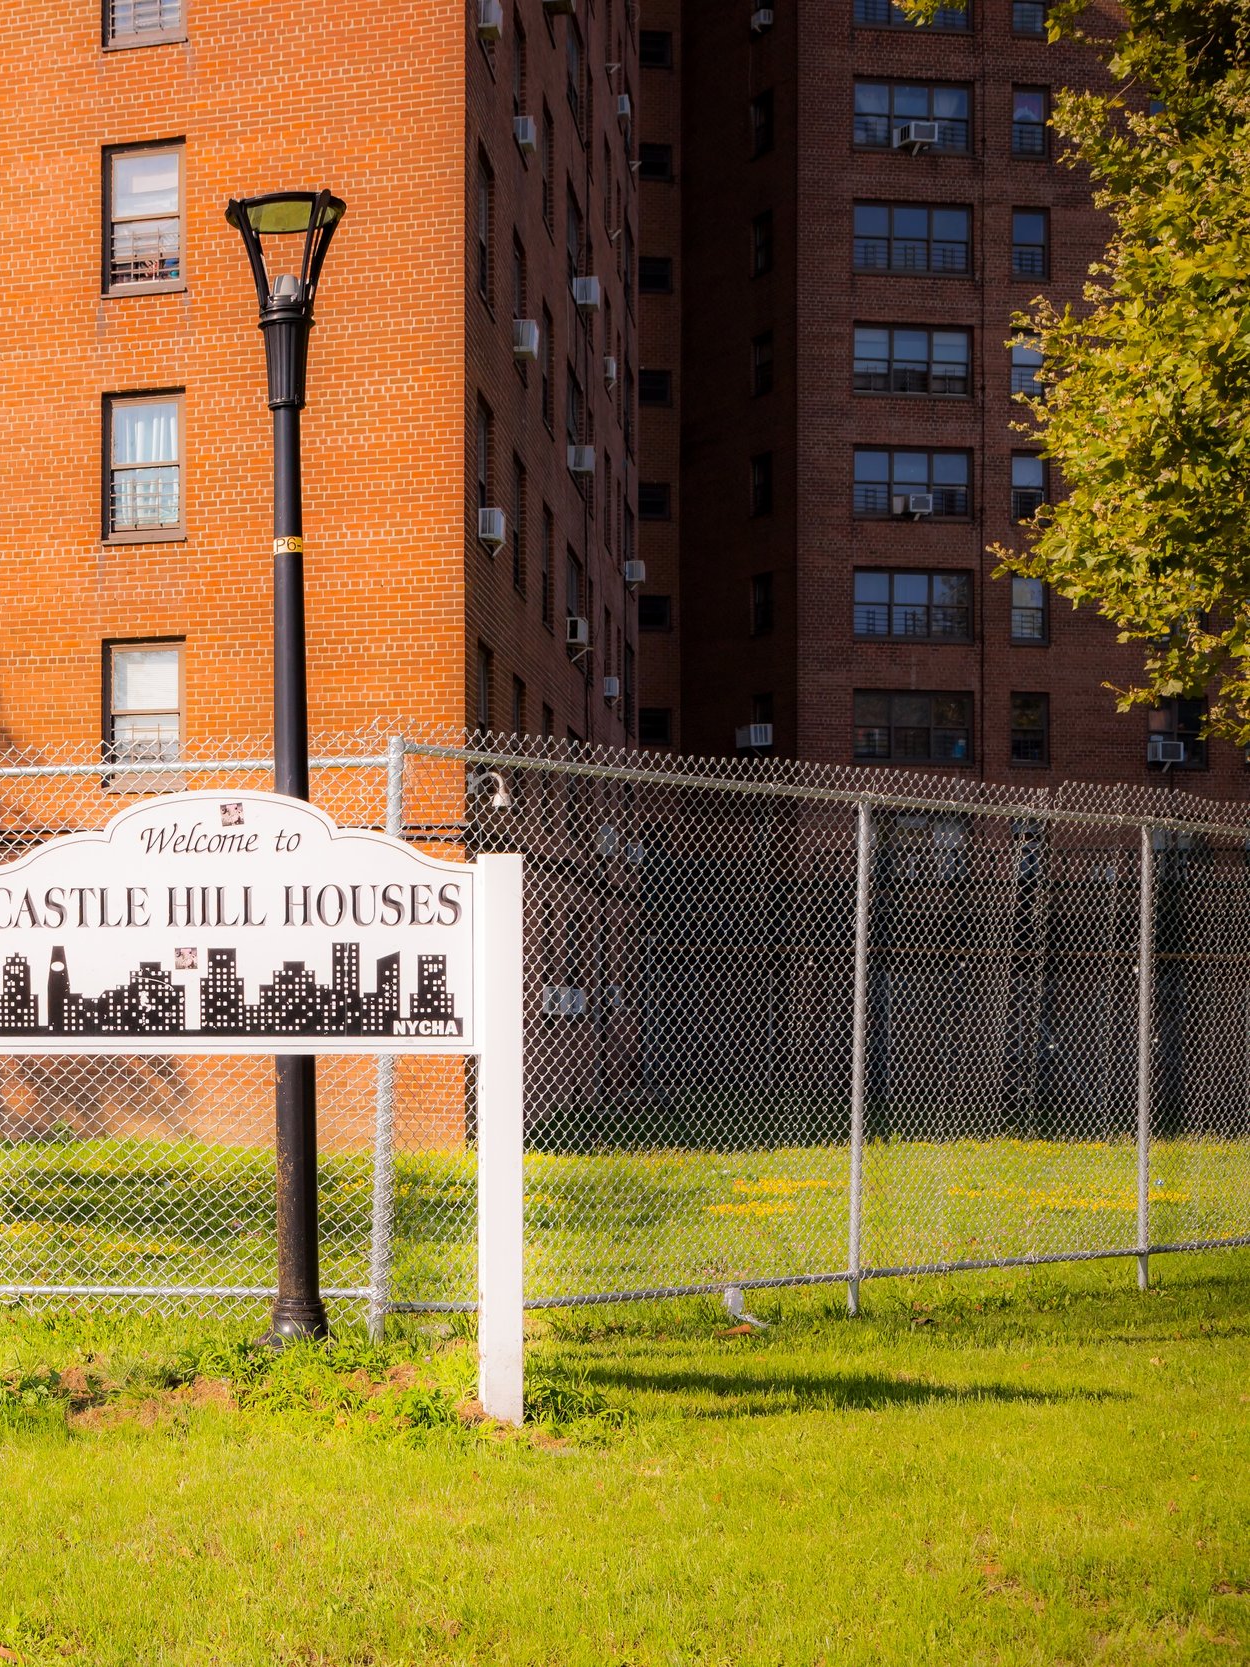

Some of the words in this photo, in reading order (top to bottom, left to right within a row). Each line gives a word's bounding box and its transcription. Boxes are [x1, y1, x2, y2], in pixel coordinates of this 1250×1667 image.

[140, 821, 259, 855] Welcome
[274, 828, 302, 854] to
[166, 884, 267, 928] HILL
[282, 882, 463, 927] HOUSES
[391, 1019, 459, 1037] NYCHA
